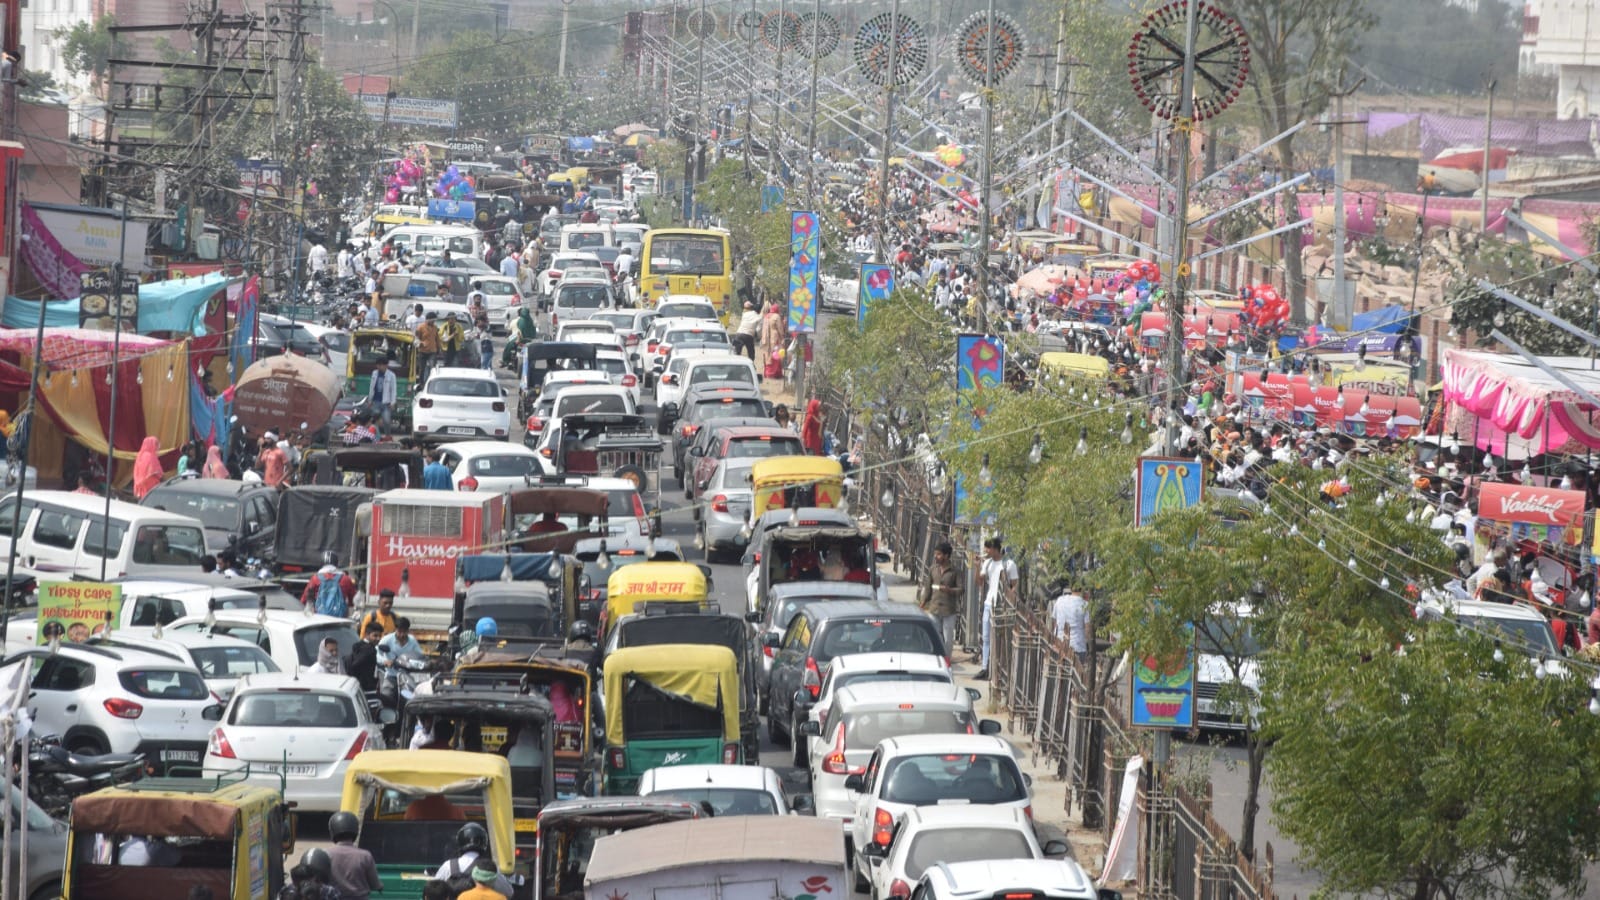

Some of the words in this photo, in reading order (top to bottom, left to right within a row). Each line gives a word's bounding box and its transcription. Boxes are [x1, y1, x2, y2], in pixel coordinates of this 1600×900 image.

[262, 169, 281, 186] PG
[76, 219, 121, 239] Amul
[85, 236, 108, 248] Milk
[1359, 336, 1386, 345] Amul
[1501, 491, 1564, 522] Vadilal
[384, 535, 468, 559] Havmor
[420, 558, 446, 567] CREAM
[645, 580, 658, 595] श्री
[659, 582, 686, 596] राम
